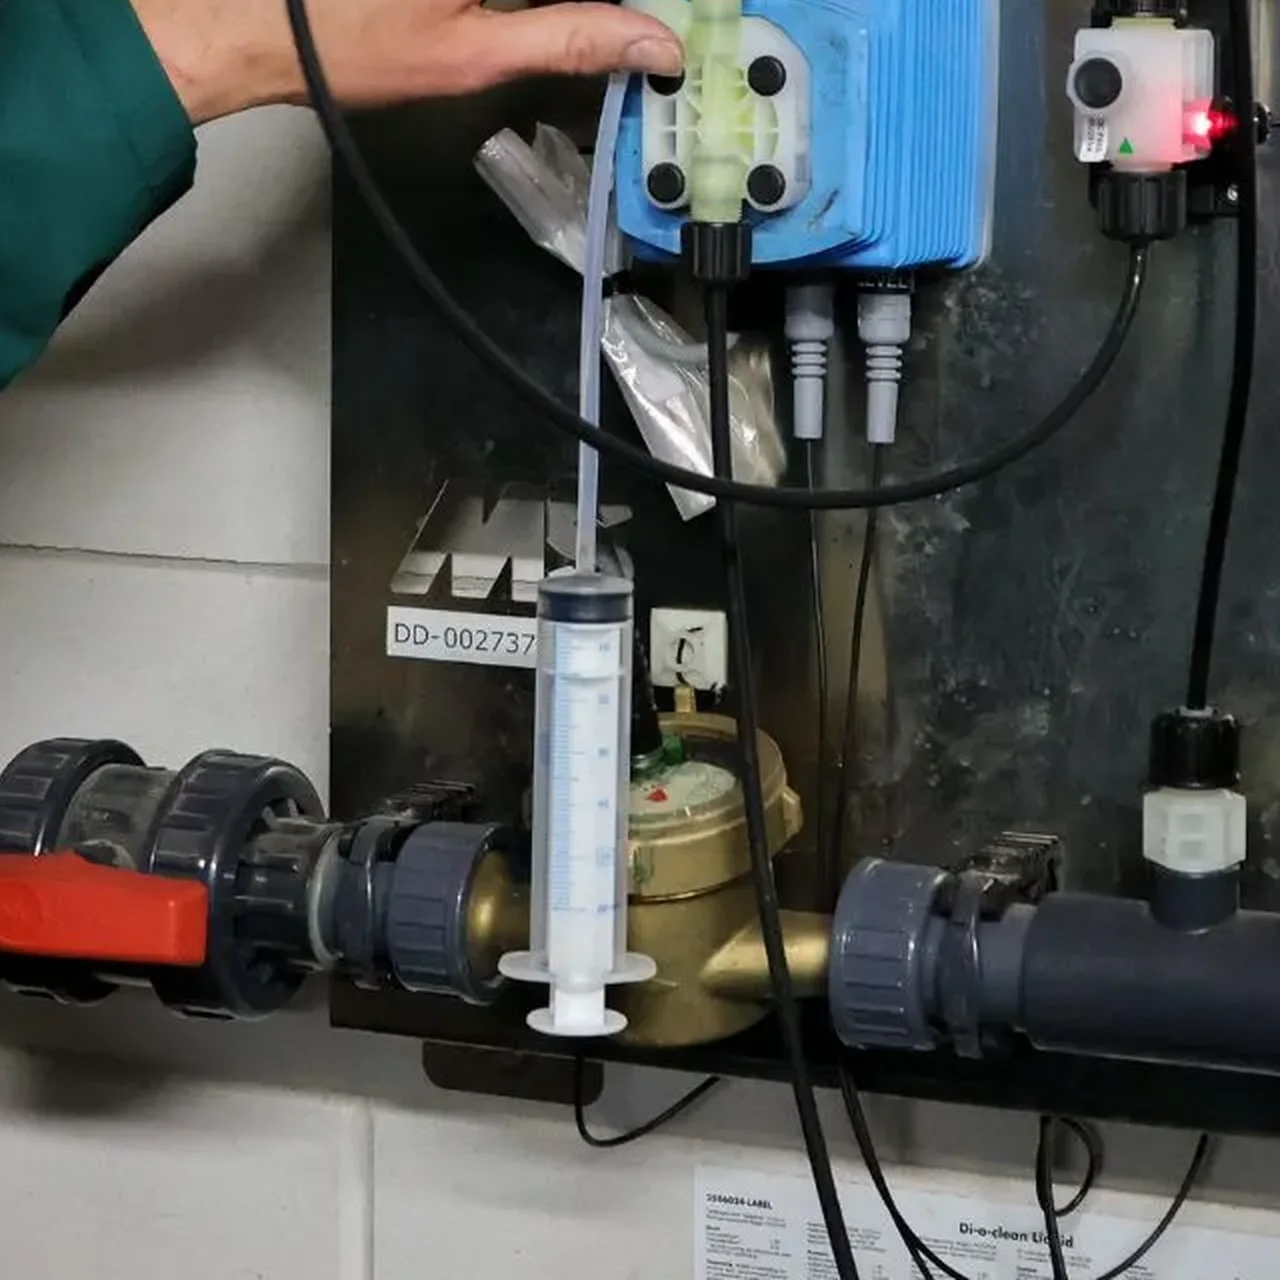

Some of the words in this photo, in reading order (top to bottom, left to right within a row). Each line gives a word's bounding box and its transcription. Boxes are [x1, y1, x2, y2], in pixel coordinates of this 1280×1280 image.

[394, 623, 536, 656] DD-002737
[959, 1223, 1027, 1242] Di-o-clean
[1032, 1231, 1074, 1248] Liid
